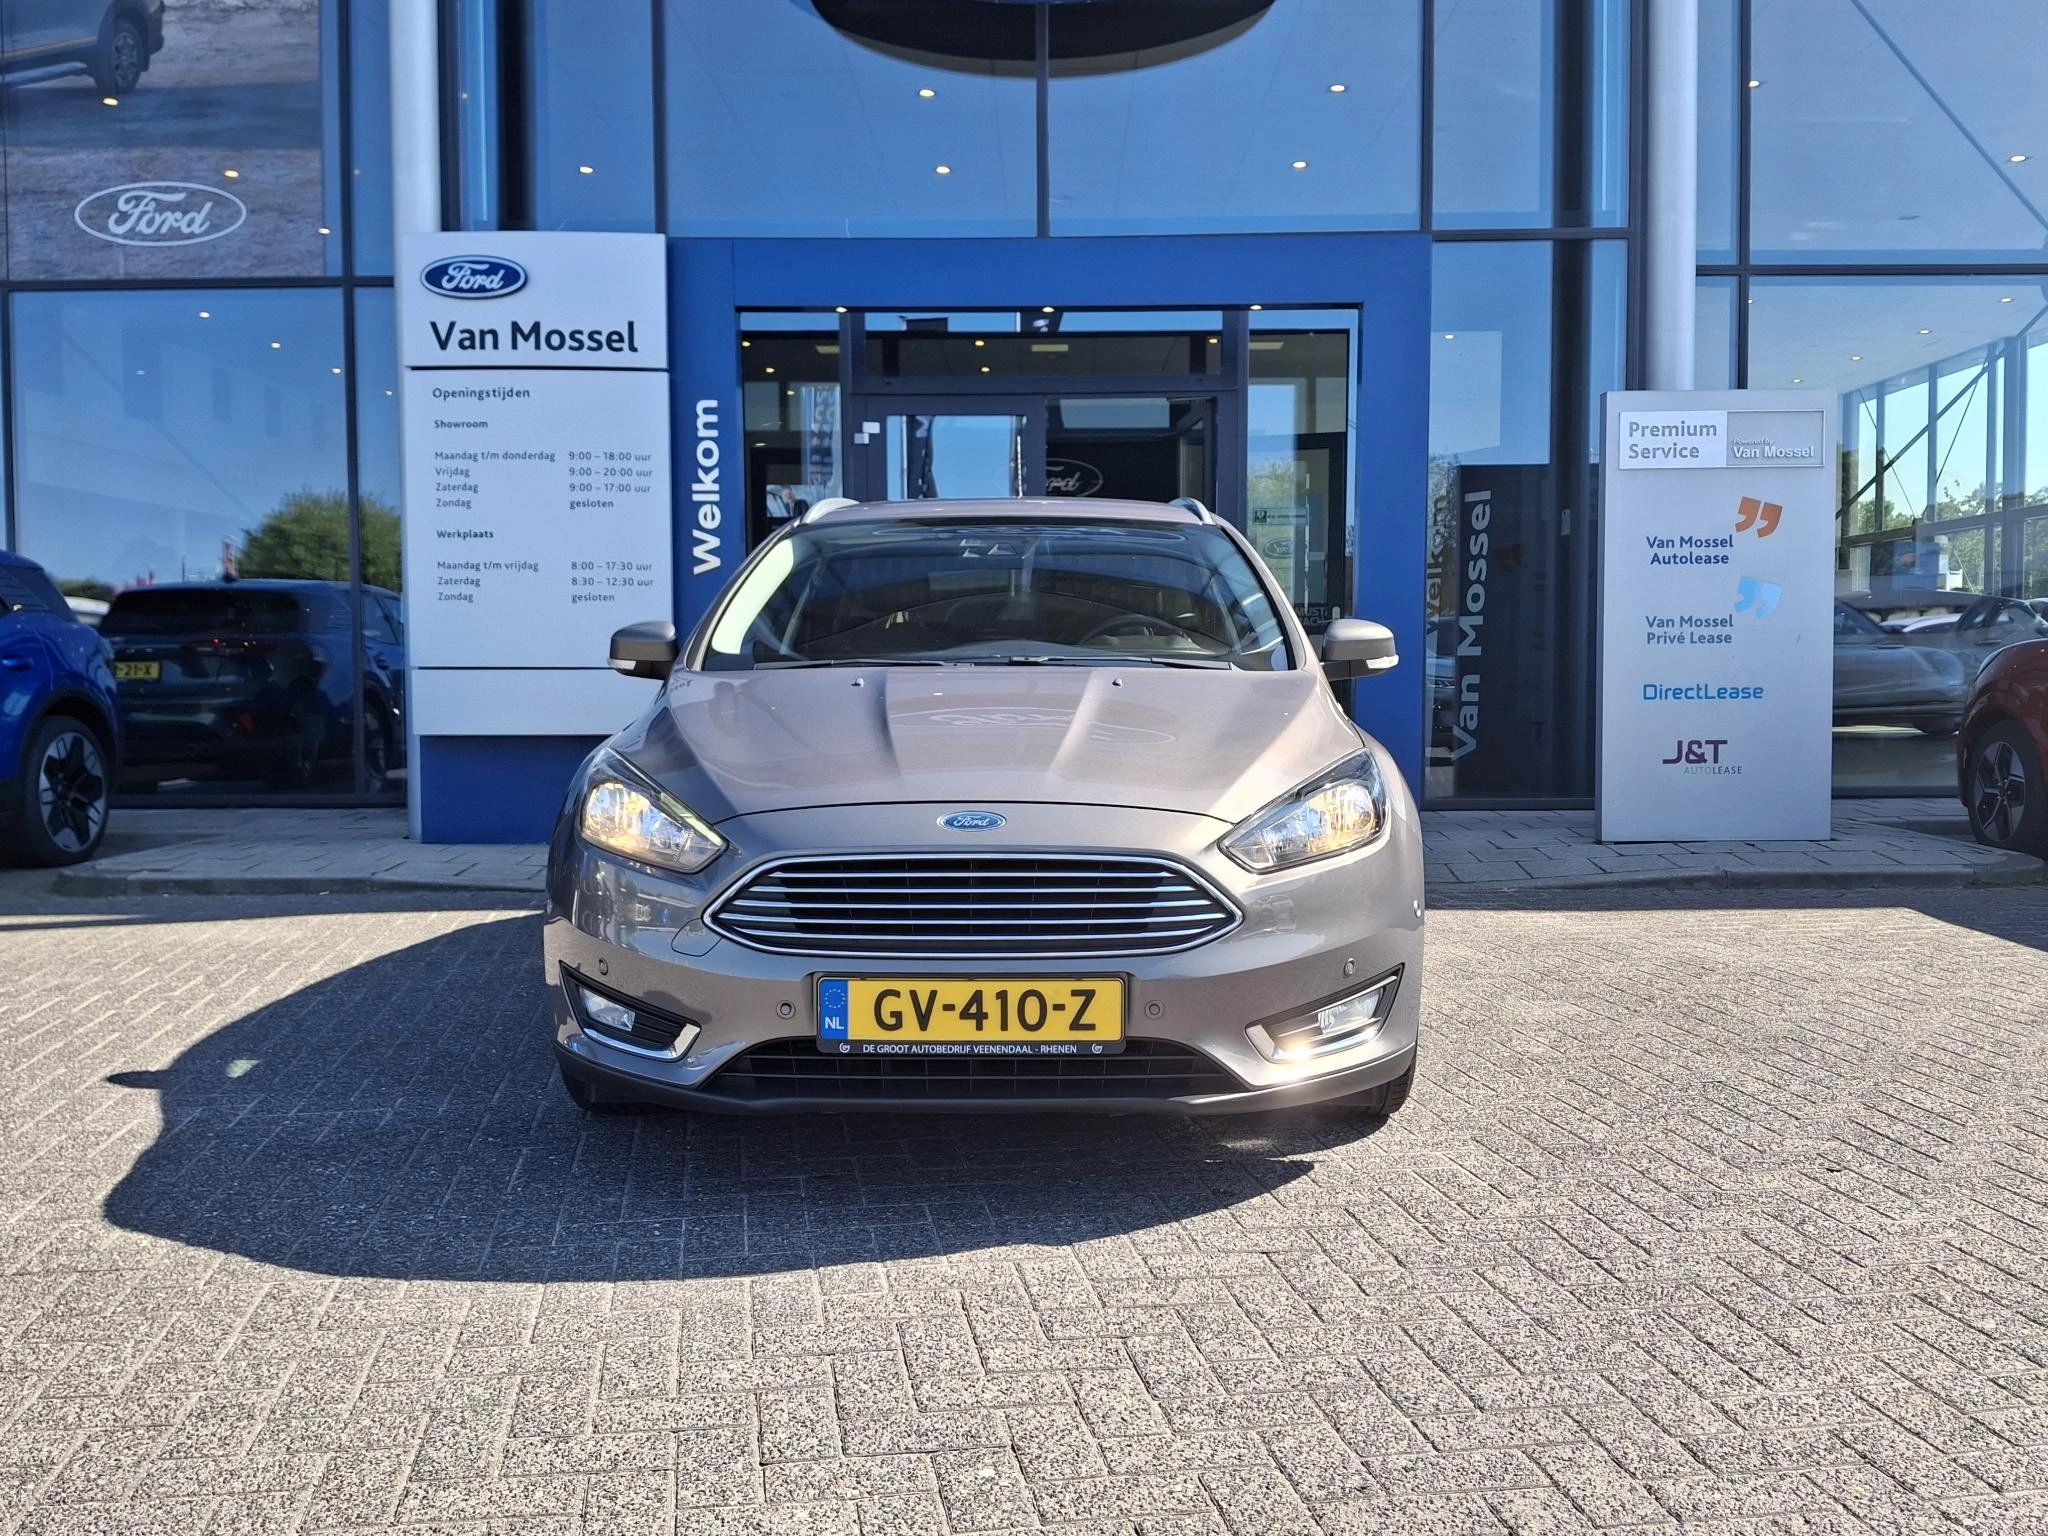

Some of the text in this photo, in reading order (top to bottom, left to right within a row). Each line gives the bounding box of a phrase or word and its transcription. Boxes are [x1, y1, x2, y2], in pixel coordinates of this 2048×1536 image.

[108, 190, 213, 234] Ford
[441, 262, 503, 290] Ford
[430, 321, 638, 352] Van Mossel
[433, 387, 530, 401] Openingstijden
[435, 420, 488, 428] Showroom
[1628, 420, 1718, 438] Premium
[435, 451, 555, 462] Maandag t/m donderdag
[569, 451, 591, 460] 9:00
[604, 452, 631, 460] 18:00
[1628, 443, 1700, 459] Service
[1733, 445, 1814, 458] Van Mossel
[435, 467, 470, 478] Vrijdag
[569, 467, 591, 476] 9:00
[604, 468, 633, 476] 20:00
[436, 483, 478, 493] Zaterdag
[569, 483, 592, 491] 9:00
[605, 483, 631, 492] 17:00
[692, 399, 722, 575] Welkom
[436, 498, 471, 509] Zondag
[570, 499, 613, 509] gesloten
[437, 530, 493, 540] Werkplaats
[1646, 535, 1734, 549] Van Mossel
[1650, 551, 1730, 565] Autolease
[438, 561, 538, 572] Maandag t/m vrijdag
[572, 562, 594, 570] 8:00
[606, 562, 633, 570] 17:30
[438, 577, 480, 587] Zaterdag
[572, 577, 594, 585] 8:30
[606, 578, 634, 586] 12:30
[438, 592, 473, 603] Zondag
[572, 592, 614, 603] gesloten
[1450, 490, 1492, 762] Van Mossel
[1645, 614, 1734, 628] Van Mossel
[1647, 631, 1732, 644] Privé Lease
[1643, 684, 1764, 700] DirectLease
[1662, 740, 1728, 765] J&T
[1683, 766, 1742, 775] AUTOLEASE
[954, 816, 990, 826] Ford
[874, 990, 1096, 1032] GV-410-Z
[825, 1016, 844, 1030] NL
[863, 1044, 874, 1053] DE
[877, 1044, 908, 1054] GROOT
[911, 1044, 971, 1054] AUTOBEDRIJF
[973, 1044, 1033, 1054] VEENENDAAL
[1041, 1043, 1077, 1054] RHENEN
